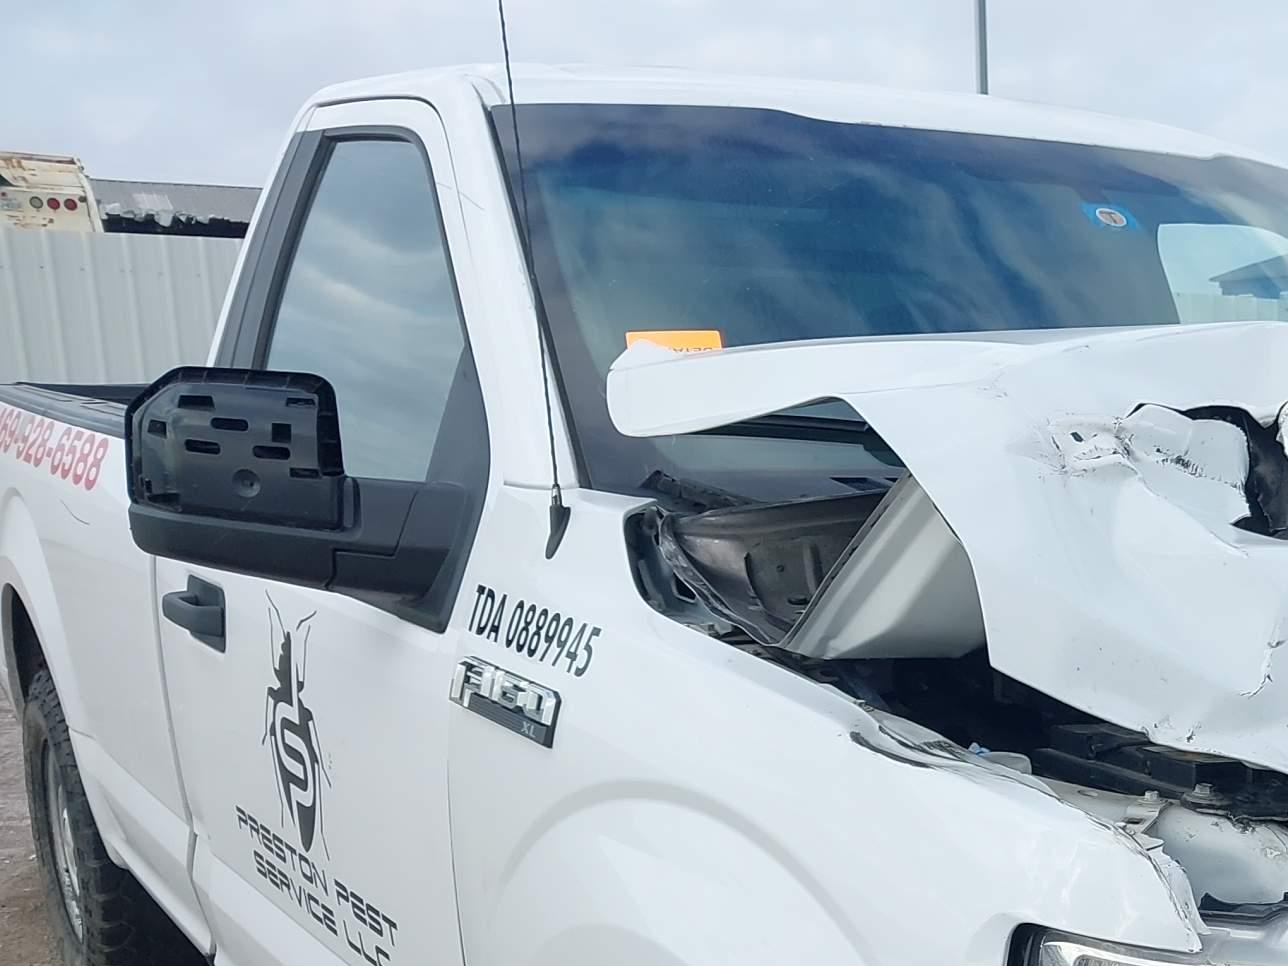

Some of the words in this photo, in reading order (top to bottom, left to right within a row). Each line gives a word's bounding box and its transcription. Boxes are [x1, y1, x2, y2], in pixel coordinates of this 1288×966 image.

[469, 584, 508, 643] TDA
[505, 600, 602, 678] 0889945
[521, 721, 536, 738] XL
[236, 805, 329, 897] PRESTON
[334, 878, 399, 947] PEST
[253, 850, 339, 937] SERVICE
